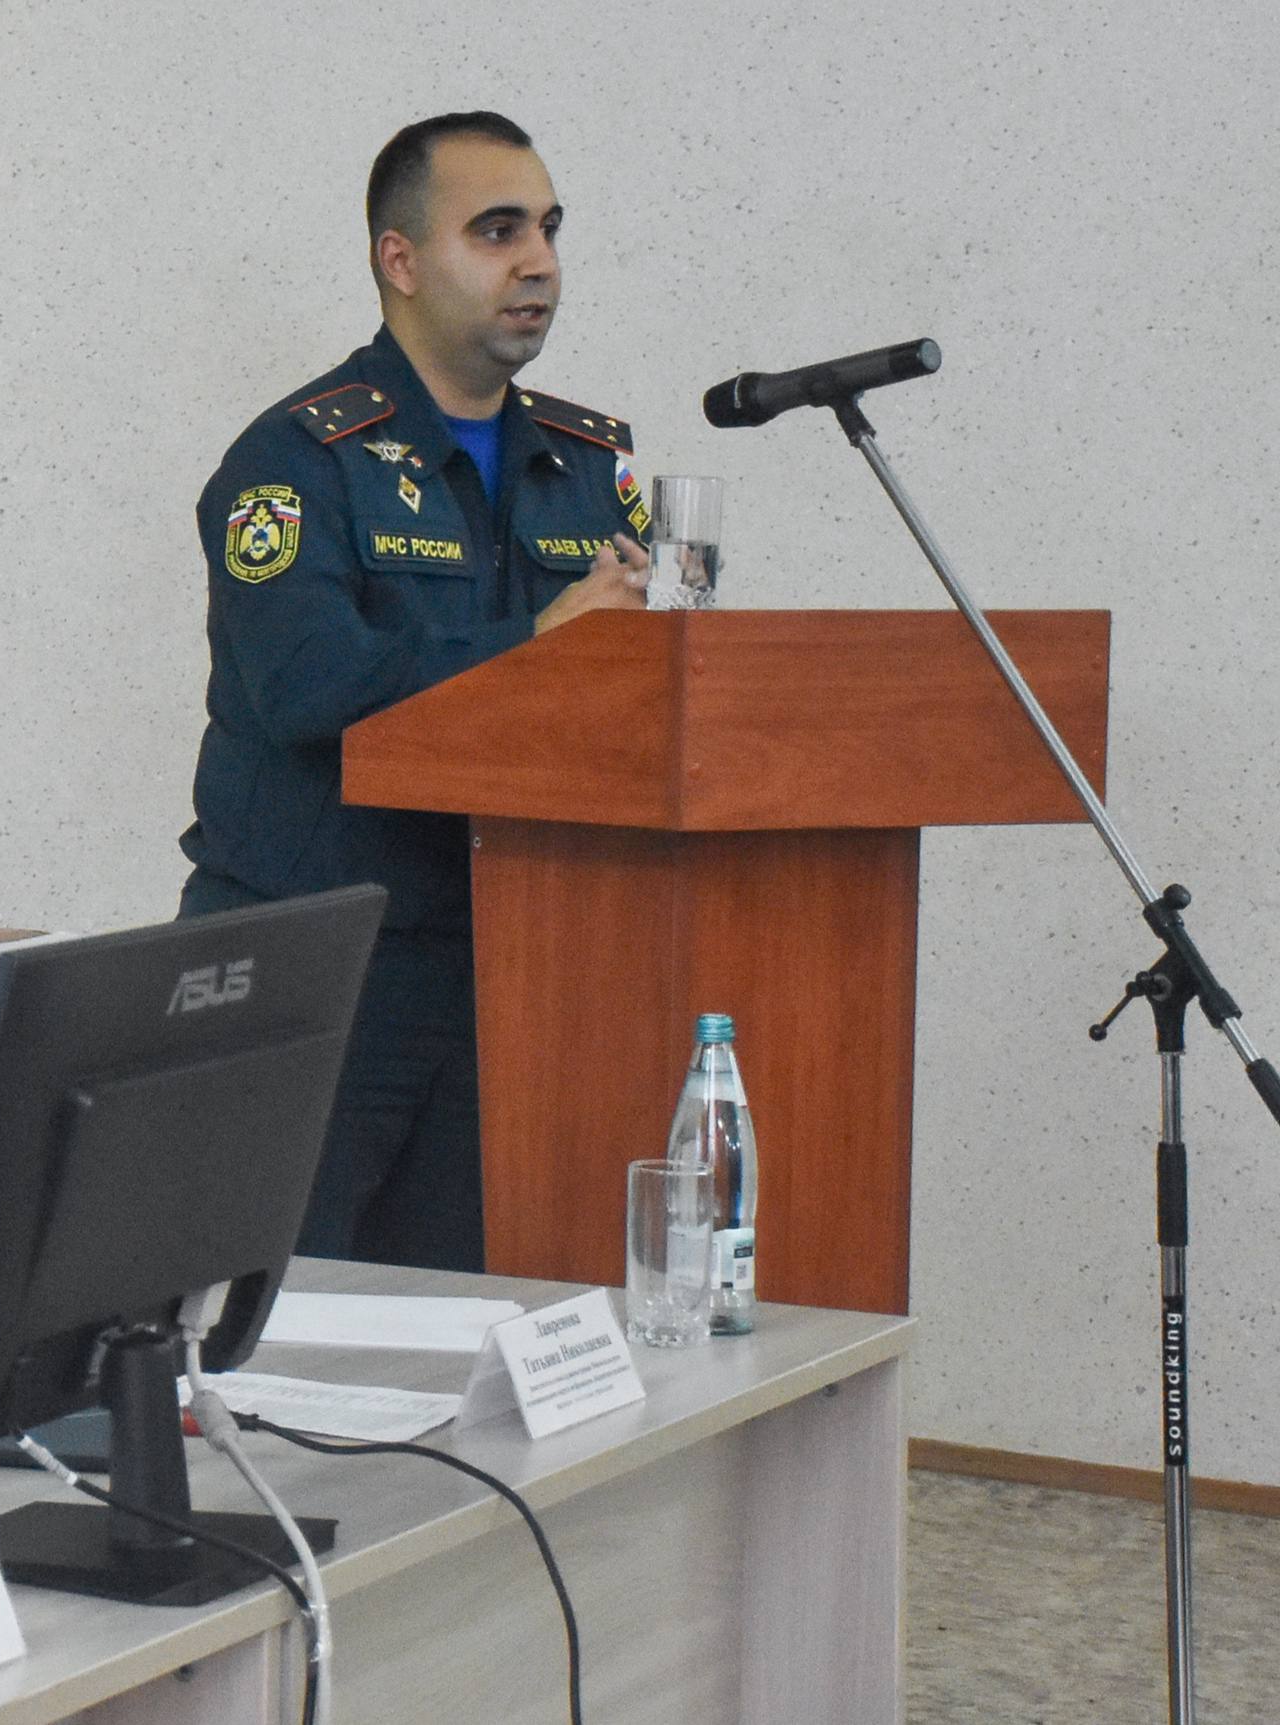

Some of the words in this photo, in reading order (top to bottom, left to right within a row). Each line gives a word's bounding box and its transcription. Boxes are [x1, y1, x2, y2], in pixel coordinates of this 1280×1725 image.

[258, 488, 289, 498] РОССИИ
[374, 535, 407, 554] МЧС
[410, 538, 463, 560] РОССИИ
[536, 539, 581, 556] РЗАЕВ
[166, 957, 254, 1016] ASUS
[522, 1351, 562, 1375] Татьяна
[559, 1334, 612, 1362] Николаевна
[1164, 1312, 1183, 1456] soundking
